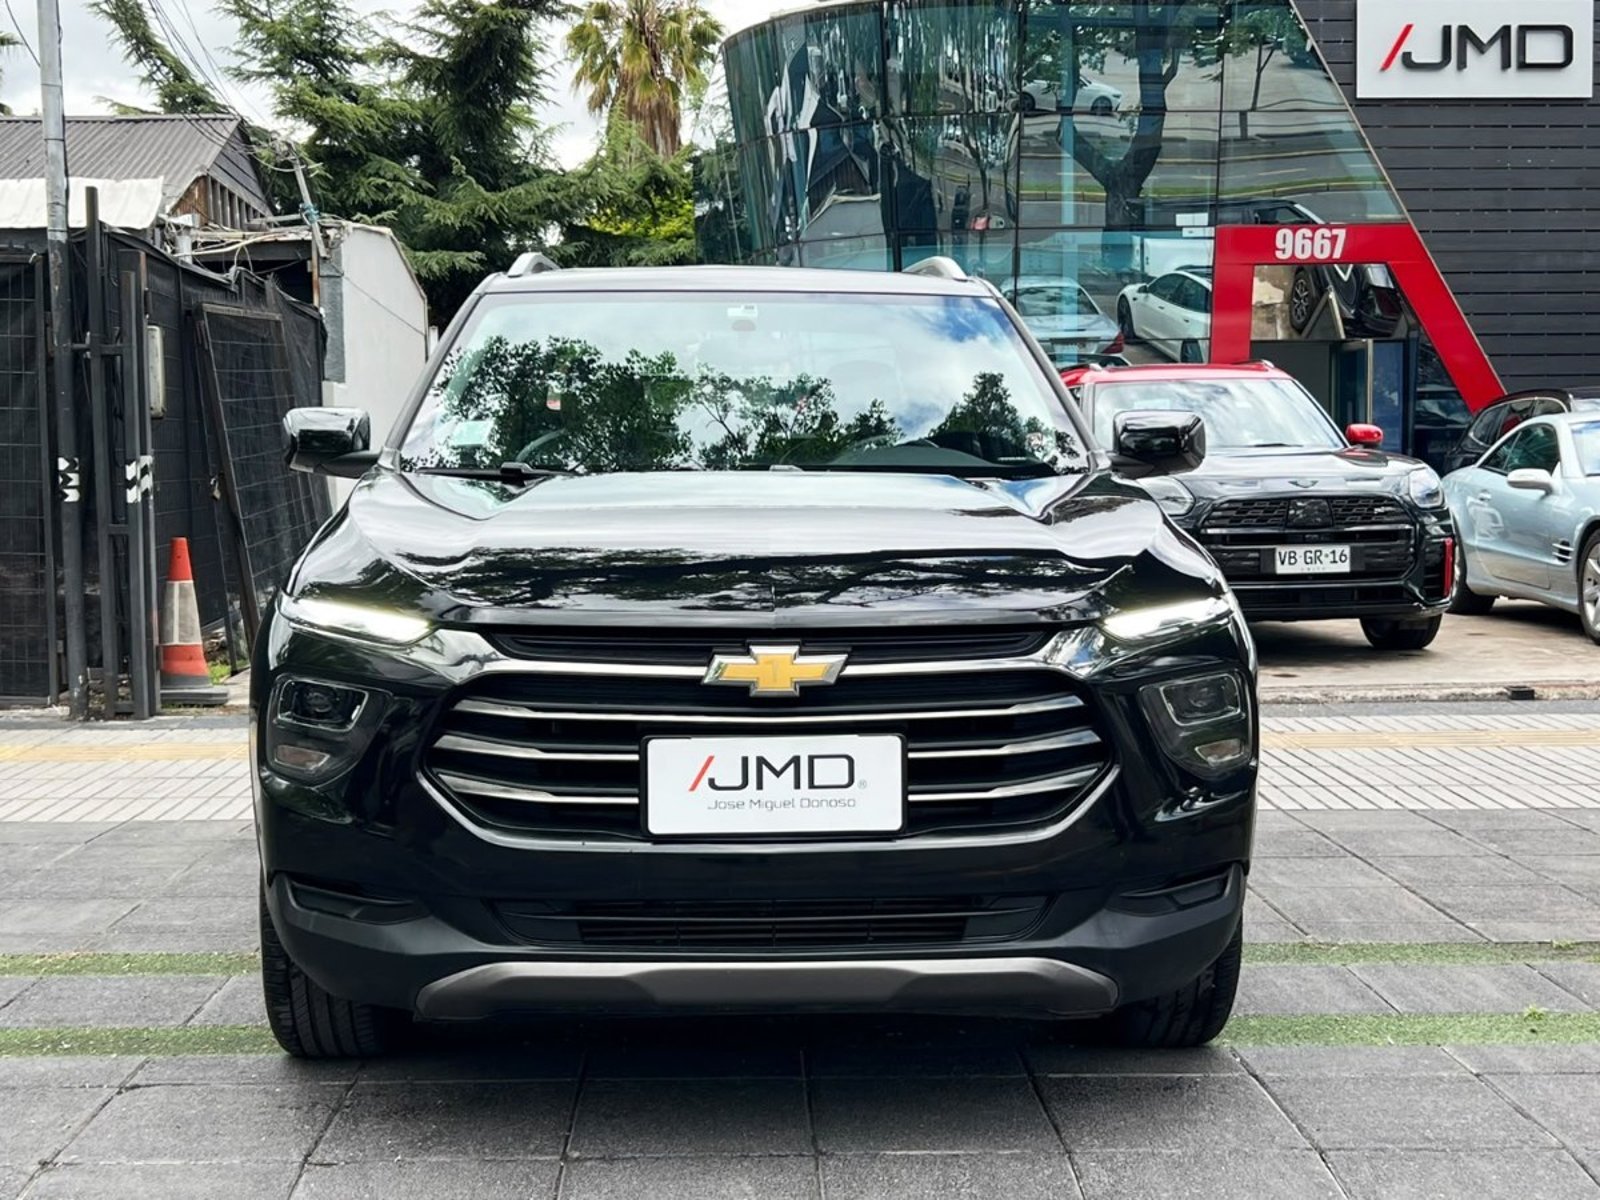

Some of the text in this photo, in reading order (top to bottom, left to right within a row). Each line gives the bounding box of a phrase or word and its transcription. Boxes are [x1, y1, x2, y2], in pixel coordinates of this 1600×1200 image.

[1275, 228, 1347, 259] 9667
[707, 797, 856, 812] Jose Miguel Donoso
